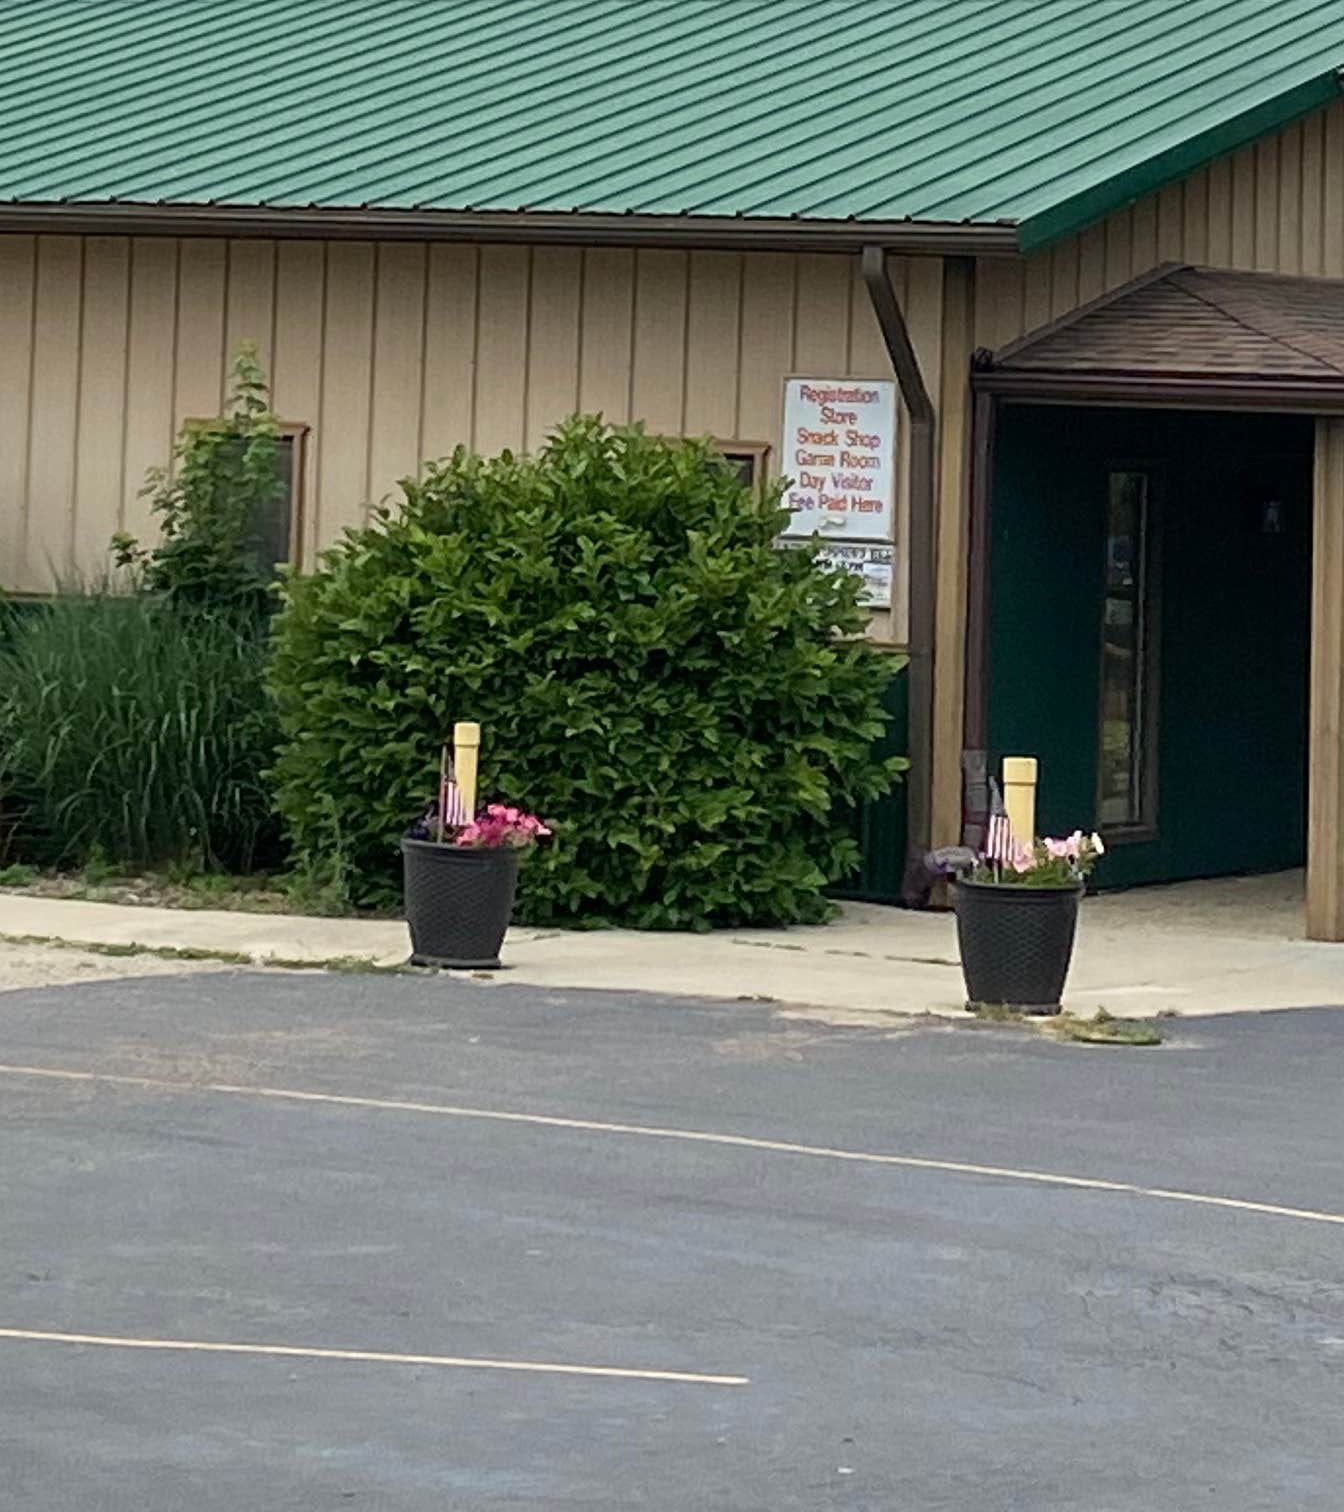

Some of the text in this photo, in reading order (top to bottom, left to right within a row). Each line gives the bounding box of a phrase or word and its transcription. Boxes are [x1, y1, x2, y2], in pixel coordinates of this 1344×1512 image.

[800, 385, 879, 406] Registration
[820, 407, 858, 425] Store
[797, 428, 881, 450] Snack Shop
[795, 449, 881, 469] Game Room
[800, 472, 874, 492] Day Visitor
[788, 492, 883, 513] Fee Paid Here
